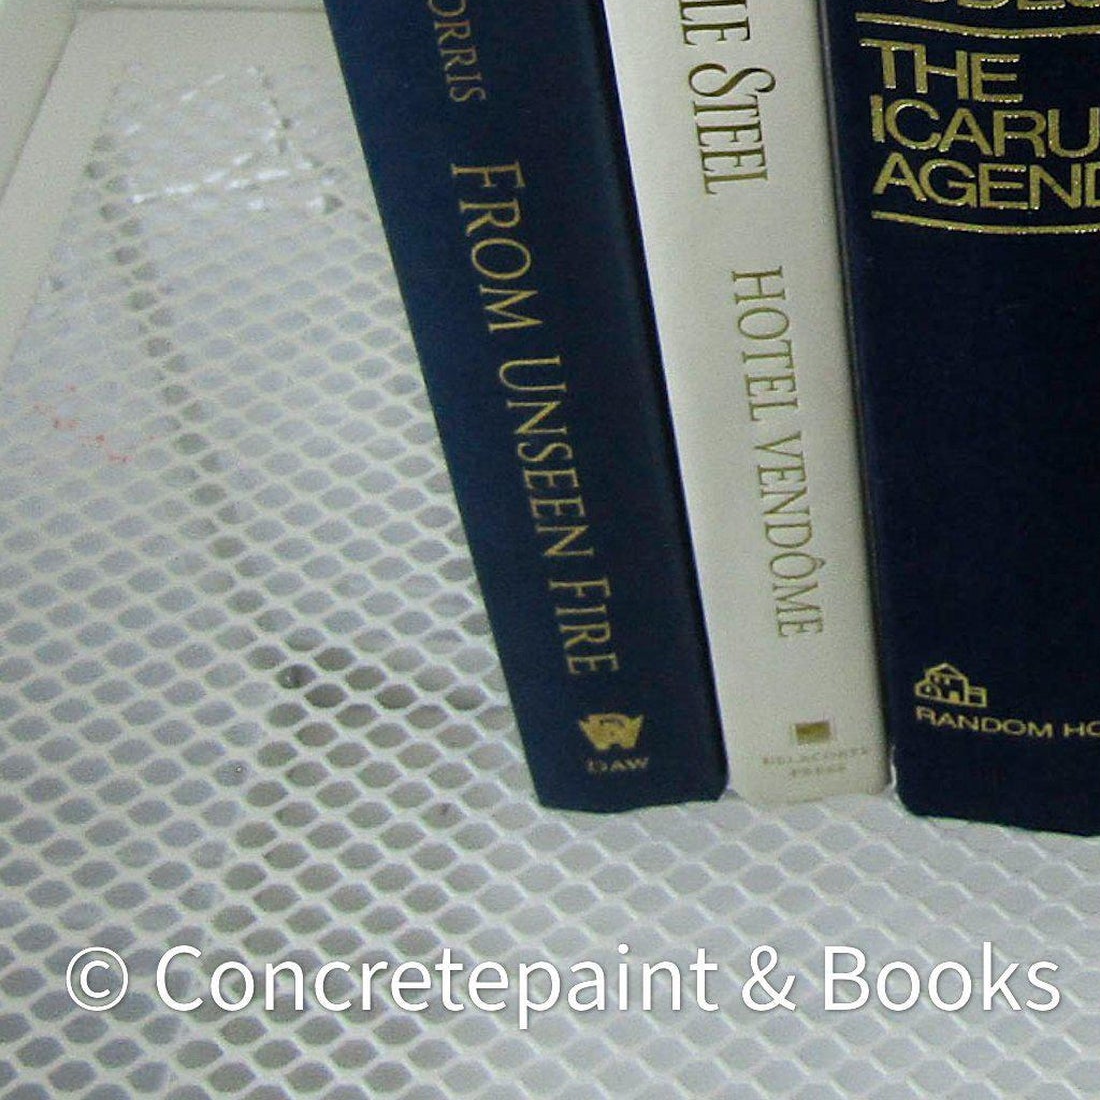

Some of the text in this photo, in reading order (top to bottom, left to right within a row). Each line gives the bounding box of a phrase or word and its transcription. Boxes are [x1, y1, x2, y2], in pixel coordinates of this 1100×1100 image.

[688, 62, 777, 196] STEEL
[859, 38, 1024, 103] THE
[451, 160, 620, 676] FROM UNSEEN FIRE
[731, 264, 827, 640] HOTEL VENDÔME
[914, 704, 1054, 739] RANDOM
